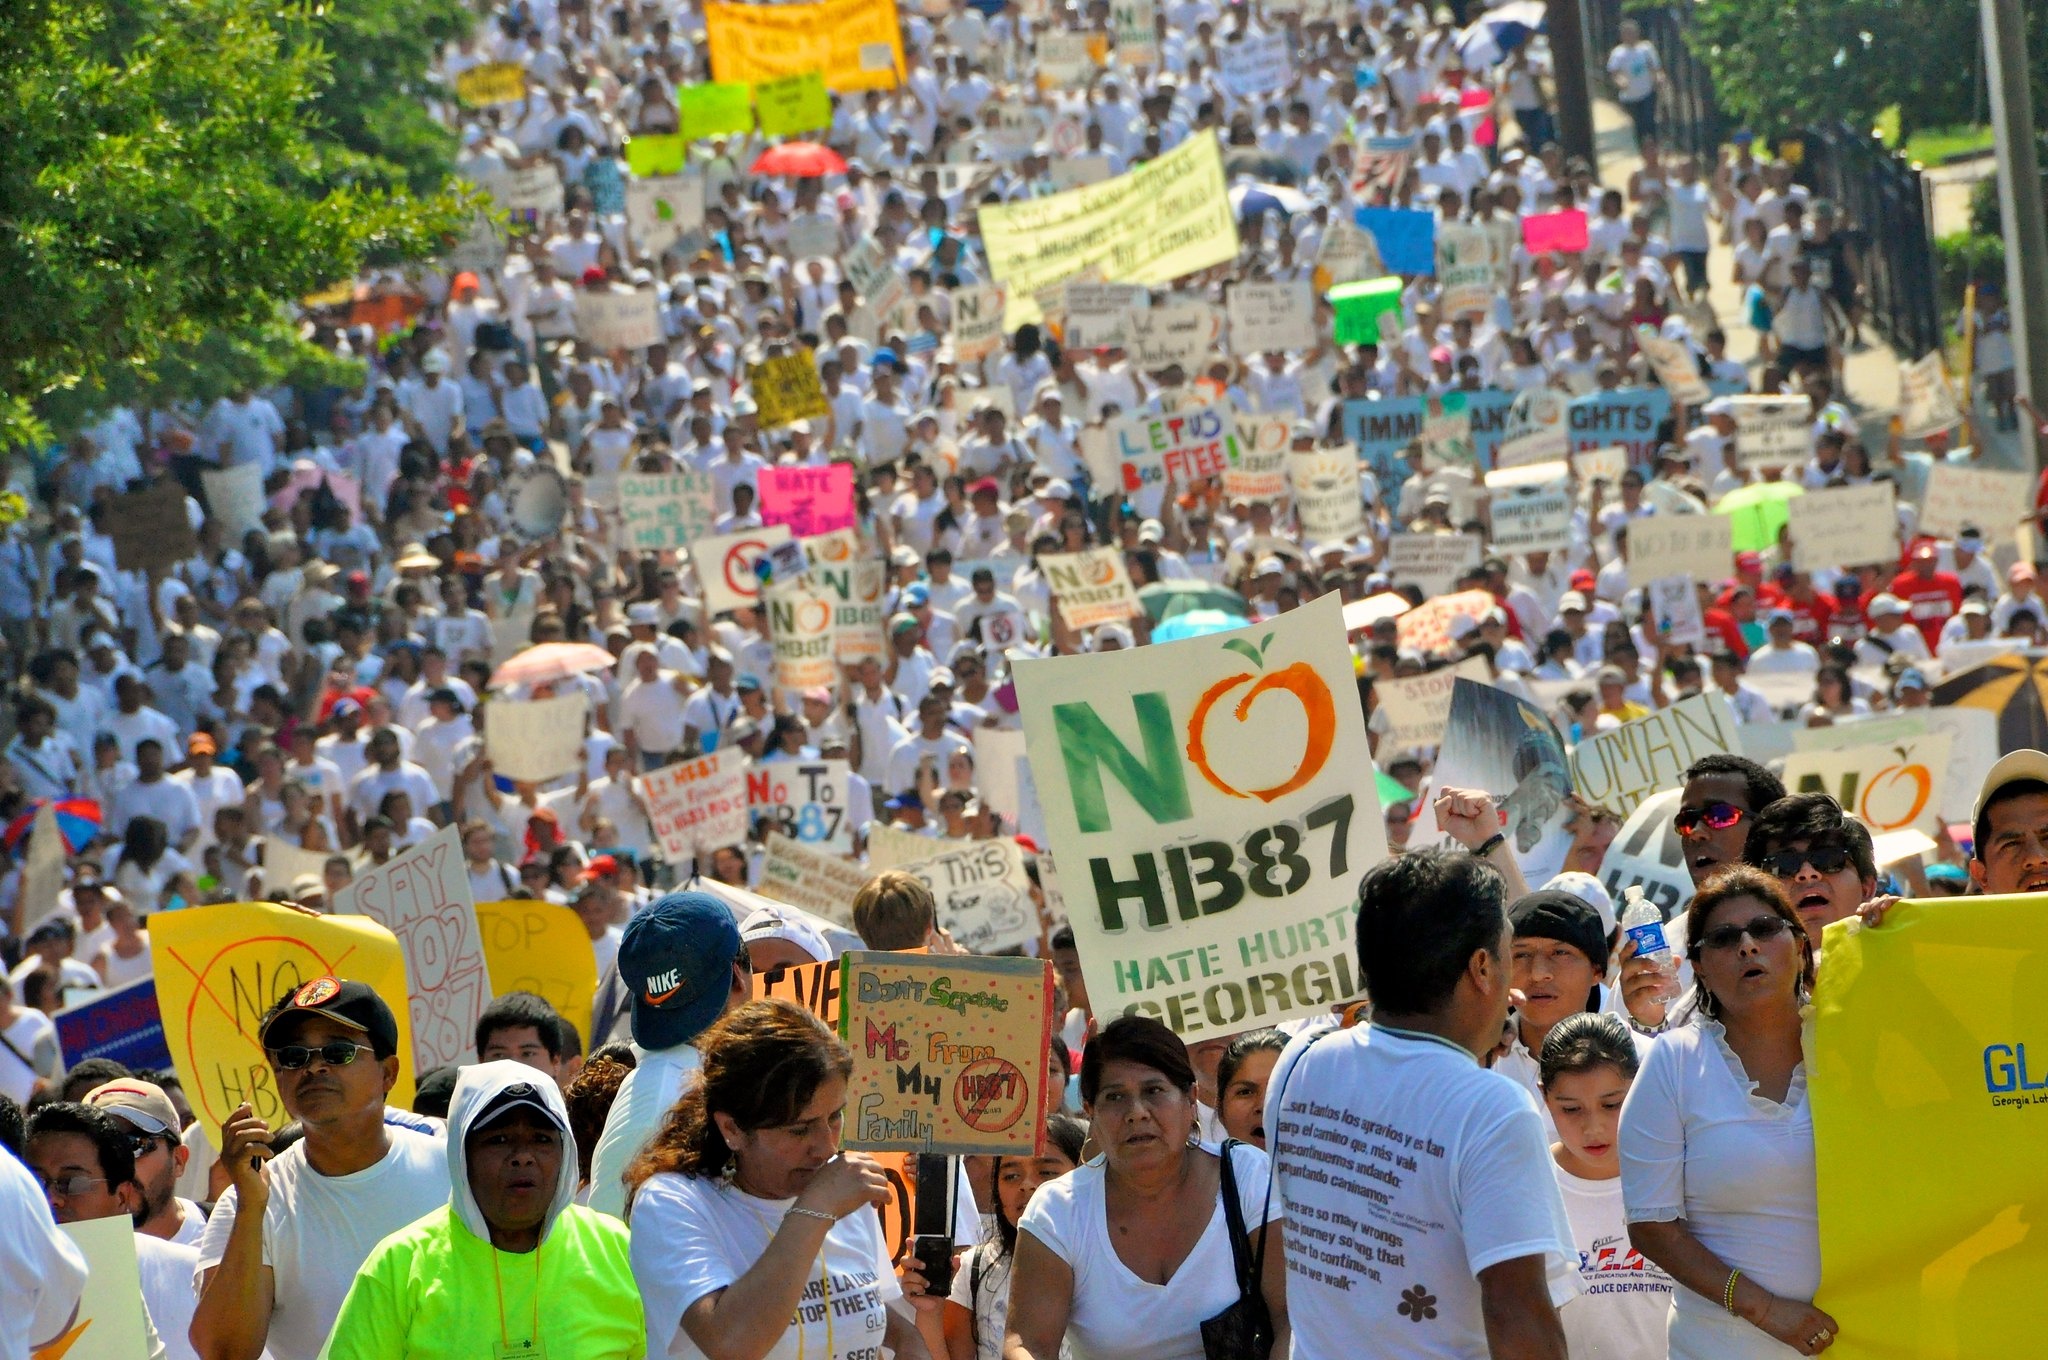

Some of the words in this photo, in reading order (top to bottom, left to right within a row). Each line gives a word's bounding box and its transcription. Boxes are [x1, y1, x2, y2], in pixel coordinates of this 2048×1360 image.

[771, 599, 832, 634] NO
[1052, 661, 1336, 833] NO
[746, 770, 788, 804] No
[798, 766, 835, 803] To
[752, 802, 843, 842] B87
[1088, 793, 1355, 933] HB87
[353, 842, 449, 929] SAY
[1112, 943, 1221, 994] HATE
[1237, 902, 1360, 968] HURT
[646, 967, 681, 994] NIKE
[1122, 952, 1368, 1034] GEORGI
[896, 1062, 942, 1106] My
[1983, 1042, 2048, 1093] GL
[1992, 1095, 2030, 1110] Georgia
[857, 1093, 934, 1153] Family
[1316, 1208, 1329, 1222] so
[1360, 1222, 1404, 1248] wrongs
[1309, 1243, 1319, 1260] to
[1377, 1246, 1406, 1268] that
[832, 1274, 854, 1294] LA
[1308, 1267, 1322, 1282] we
[1616, 1282, 1674, 1294] DEPARTMENT
[830, 1295, 867, 1318] THE
